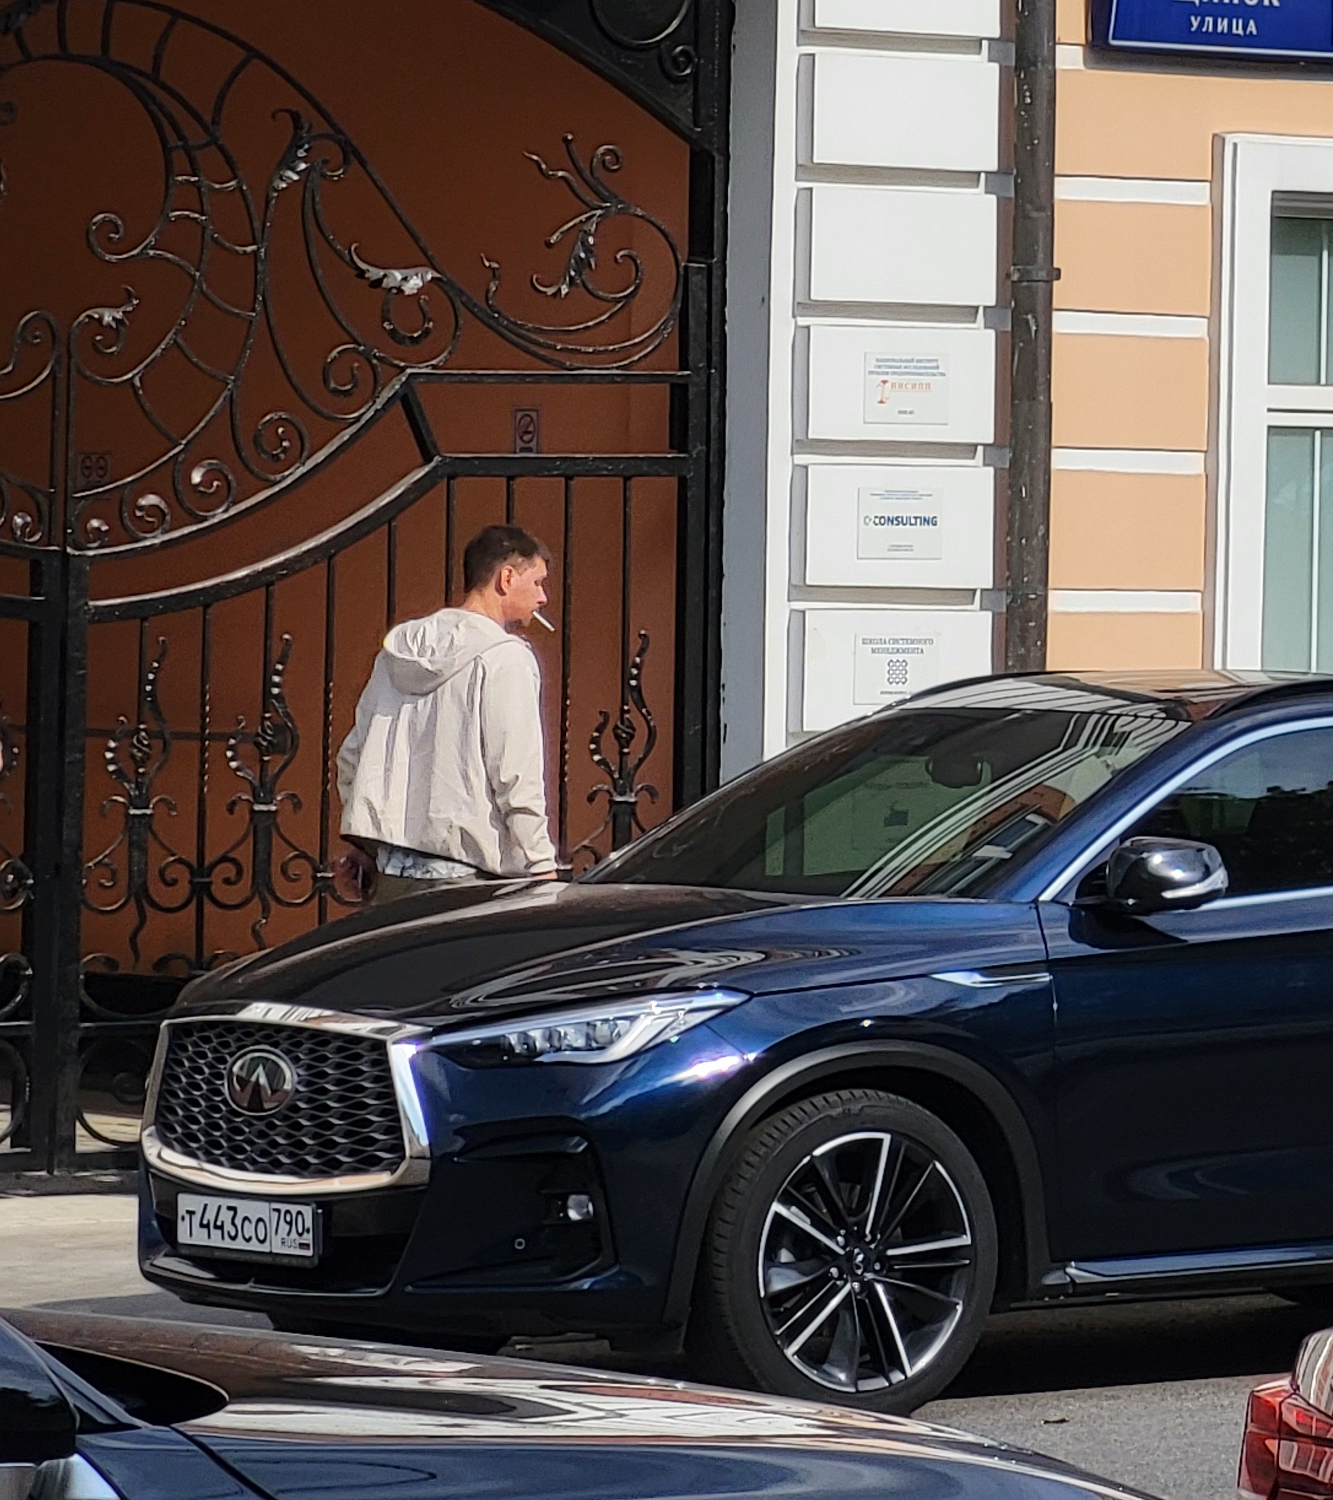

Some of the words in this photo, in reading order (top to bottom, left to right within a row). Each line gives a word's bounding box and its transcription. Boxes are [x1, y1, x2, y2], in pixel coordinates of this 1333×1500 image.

[1189, 15, 1259, 36] УЛИЦА
[873, 515, 938, 527] CONSULTING
[281, 1237, 298, 1249] RUS
